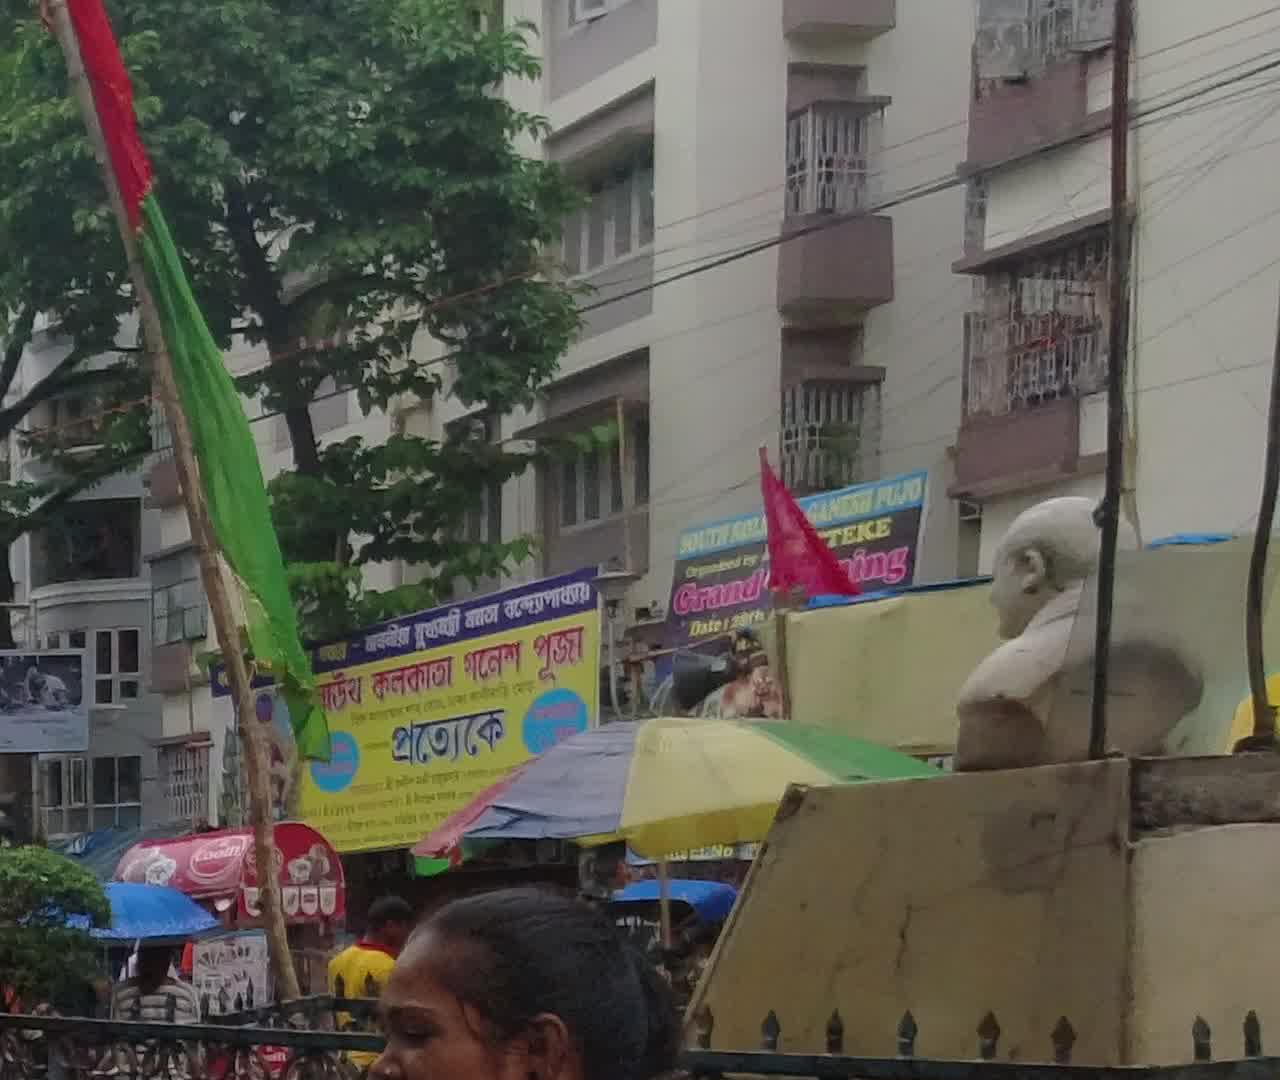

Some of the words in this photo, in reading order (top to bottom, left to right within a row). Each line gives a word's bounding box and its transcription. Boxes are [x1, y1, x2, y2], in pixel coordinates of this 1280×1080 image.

[673, 568, 763, 615] Grand
[372, 656, 454, 700] কলকাতা
[533, 625, 585, 681] পূজা
[391, 708, 505, 766] প্রত্যেকে
